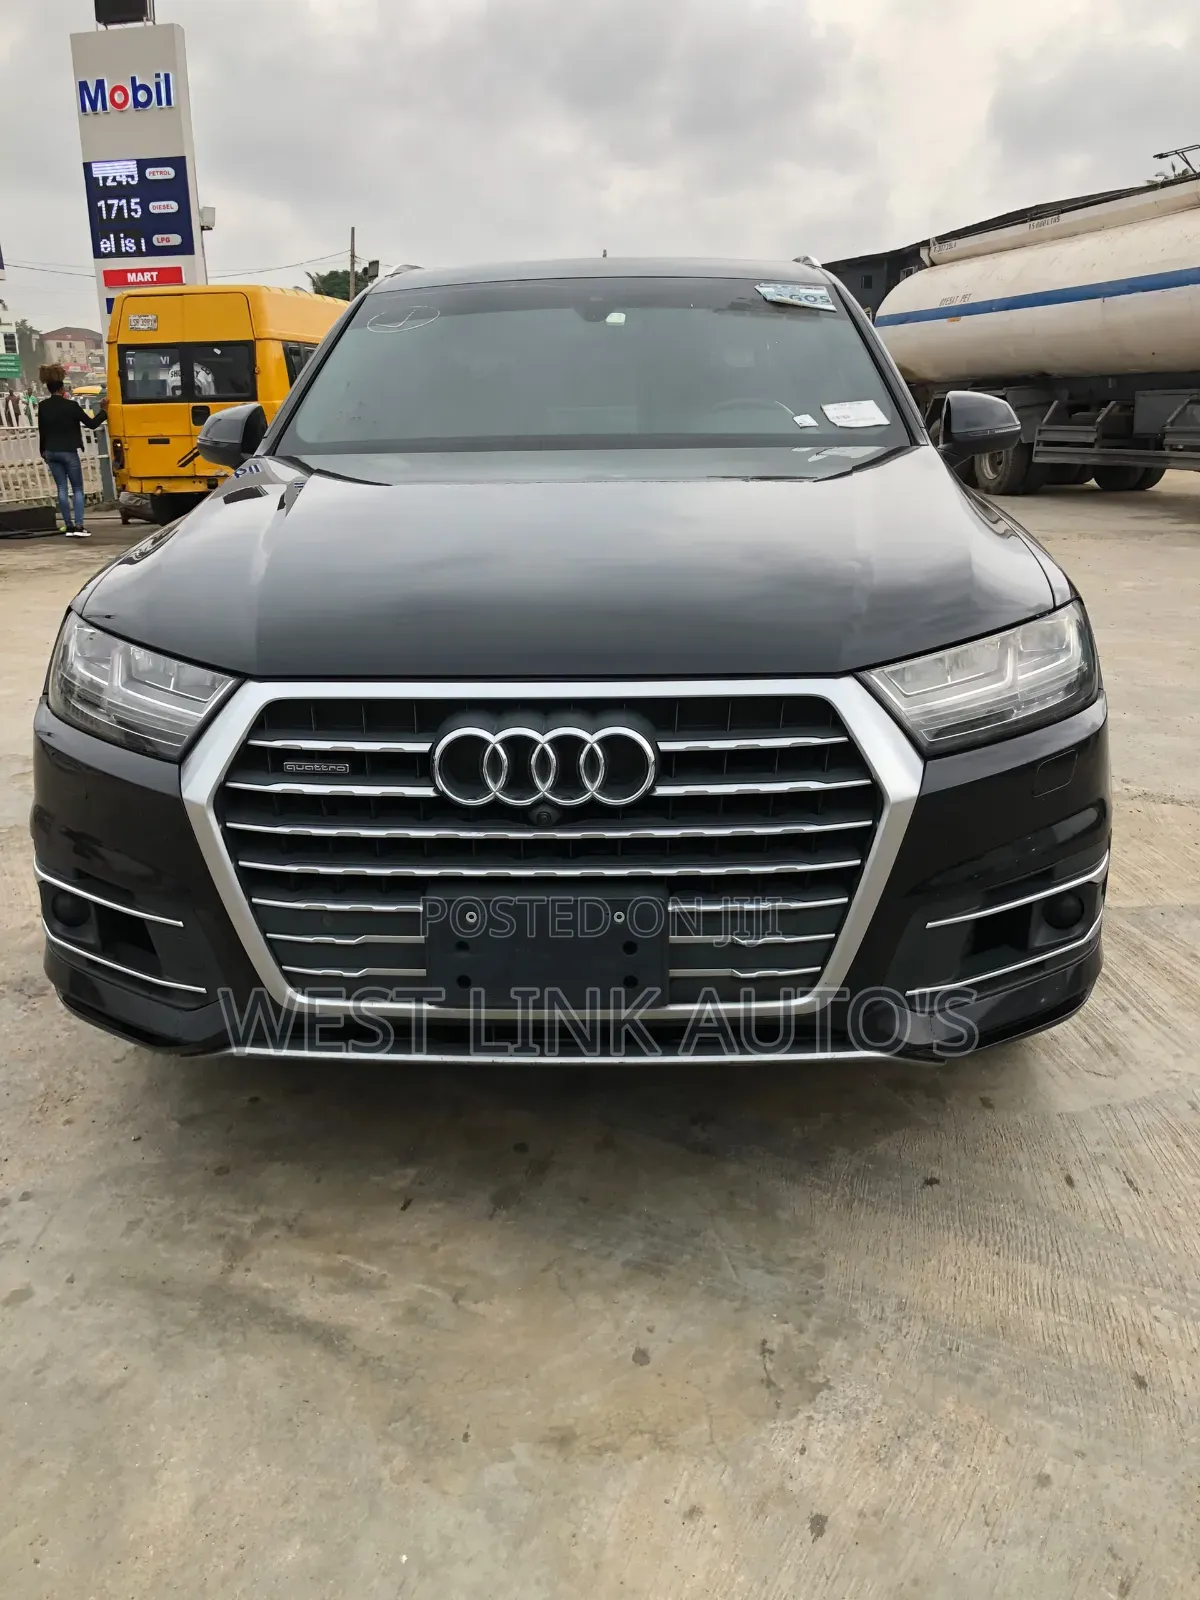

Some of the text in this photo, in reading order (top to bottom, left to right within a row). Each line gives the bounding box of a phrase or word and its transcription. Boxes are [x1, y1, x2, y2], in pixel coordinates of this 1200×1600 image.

[78, 72, 173, 114] Mobil
[97, 198, 142, 220] 1715
[100, 233, 116, 253] el
[120, 233, 136, 253] is
[156, 236, 171, 244] LPG
[127, 271, 158, 283] MART
[286, 764, 346, 772] quattro
